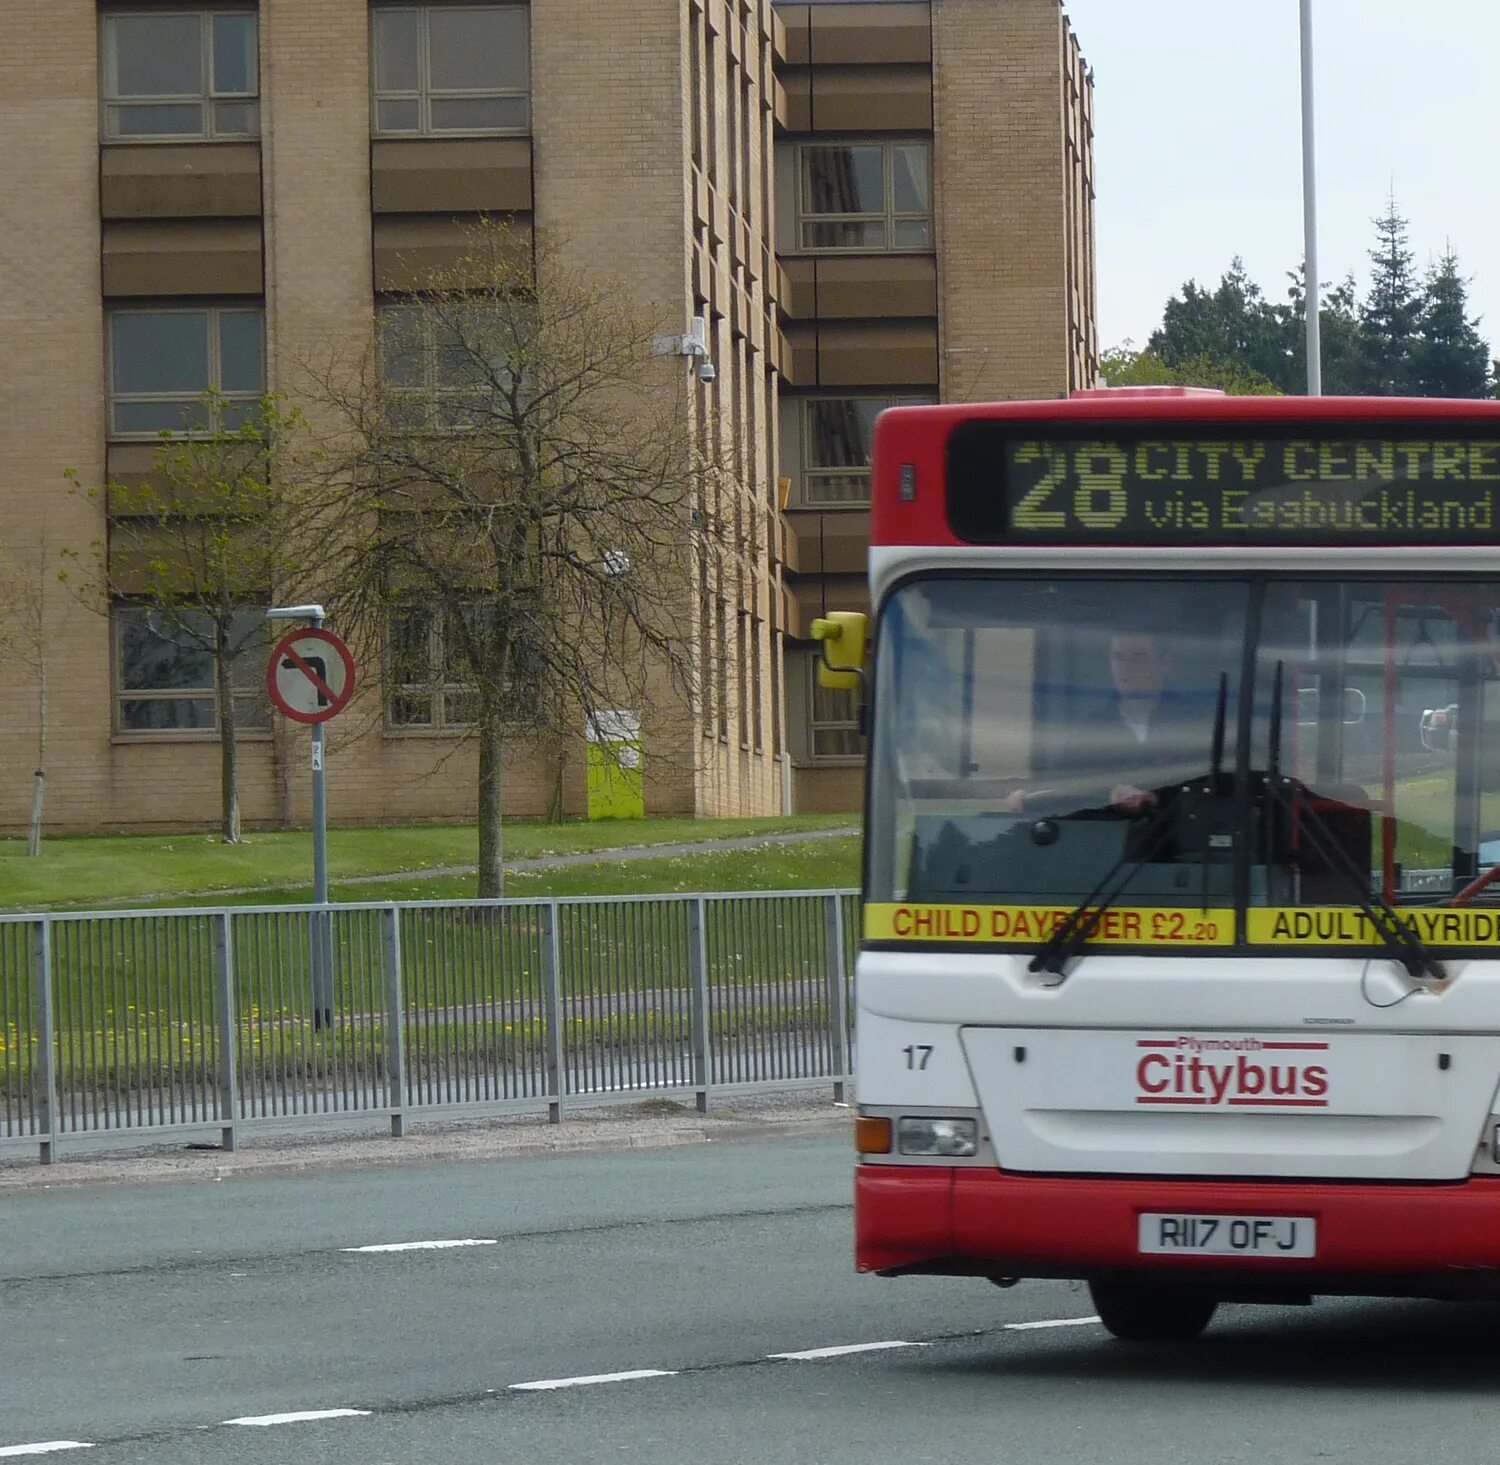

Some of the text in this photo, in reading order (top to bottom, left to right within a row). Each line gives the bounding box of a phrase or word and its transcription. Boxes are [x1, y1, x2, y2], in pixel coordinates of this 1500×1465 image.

[1013, 441, 1128, 528] 28
[1135, 440, 1266, 480] CITY
[1145, 490, 1492, 528] via Eggbuckland
[893, 908, 1218, 941] CHILD DAYRDER £2.20
[1272, 913, 1370, 941] ADULT
[902, 1045, 934, 1070] 17
[1137, 1036, 1328, 1105] Plymouth Citybus
[1160, 1218, 1296, 1250] R117 OFJ
